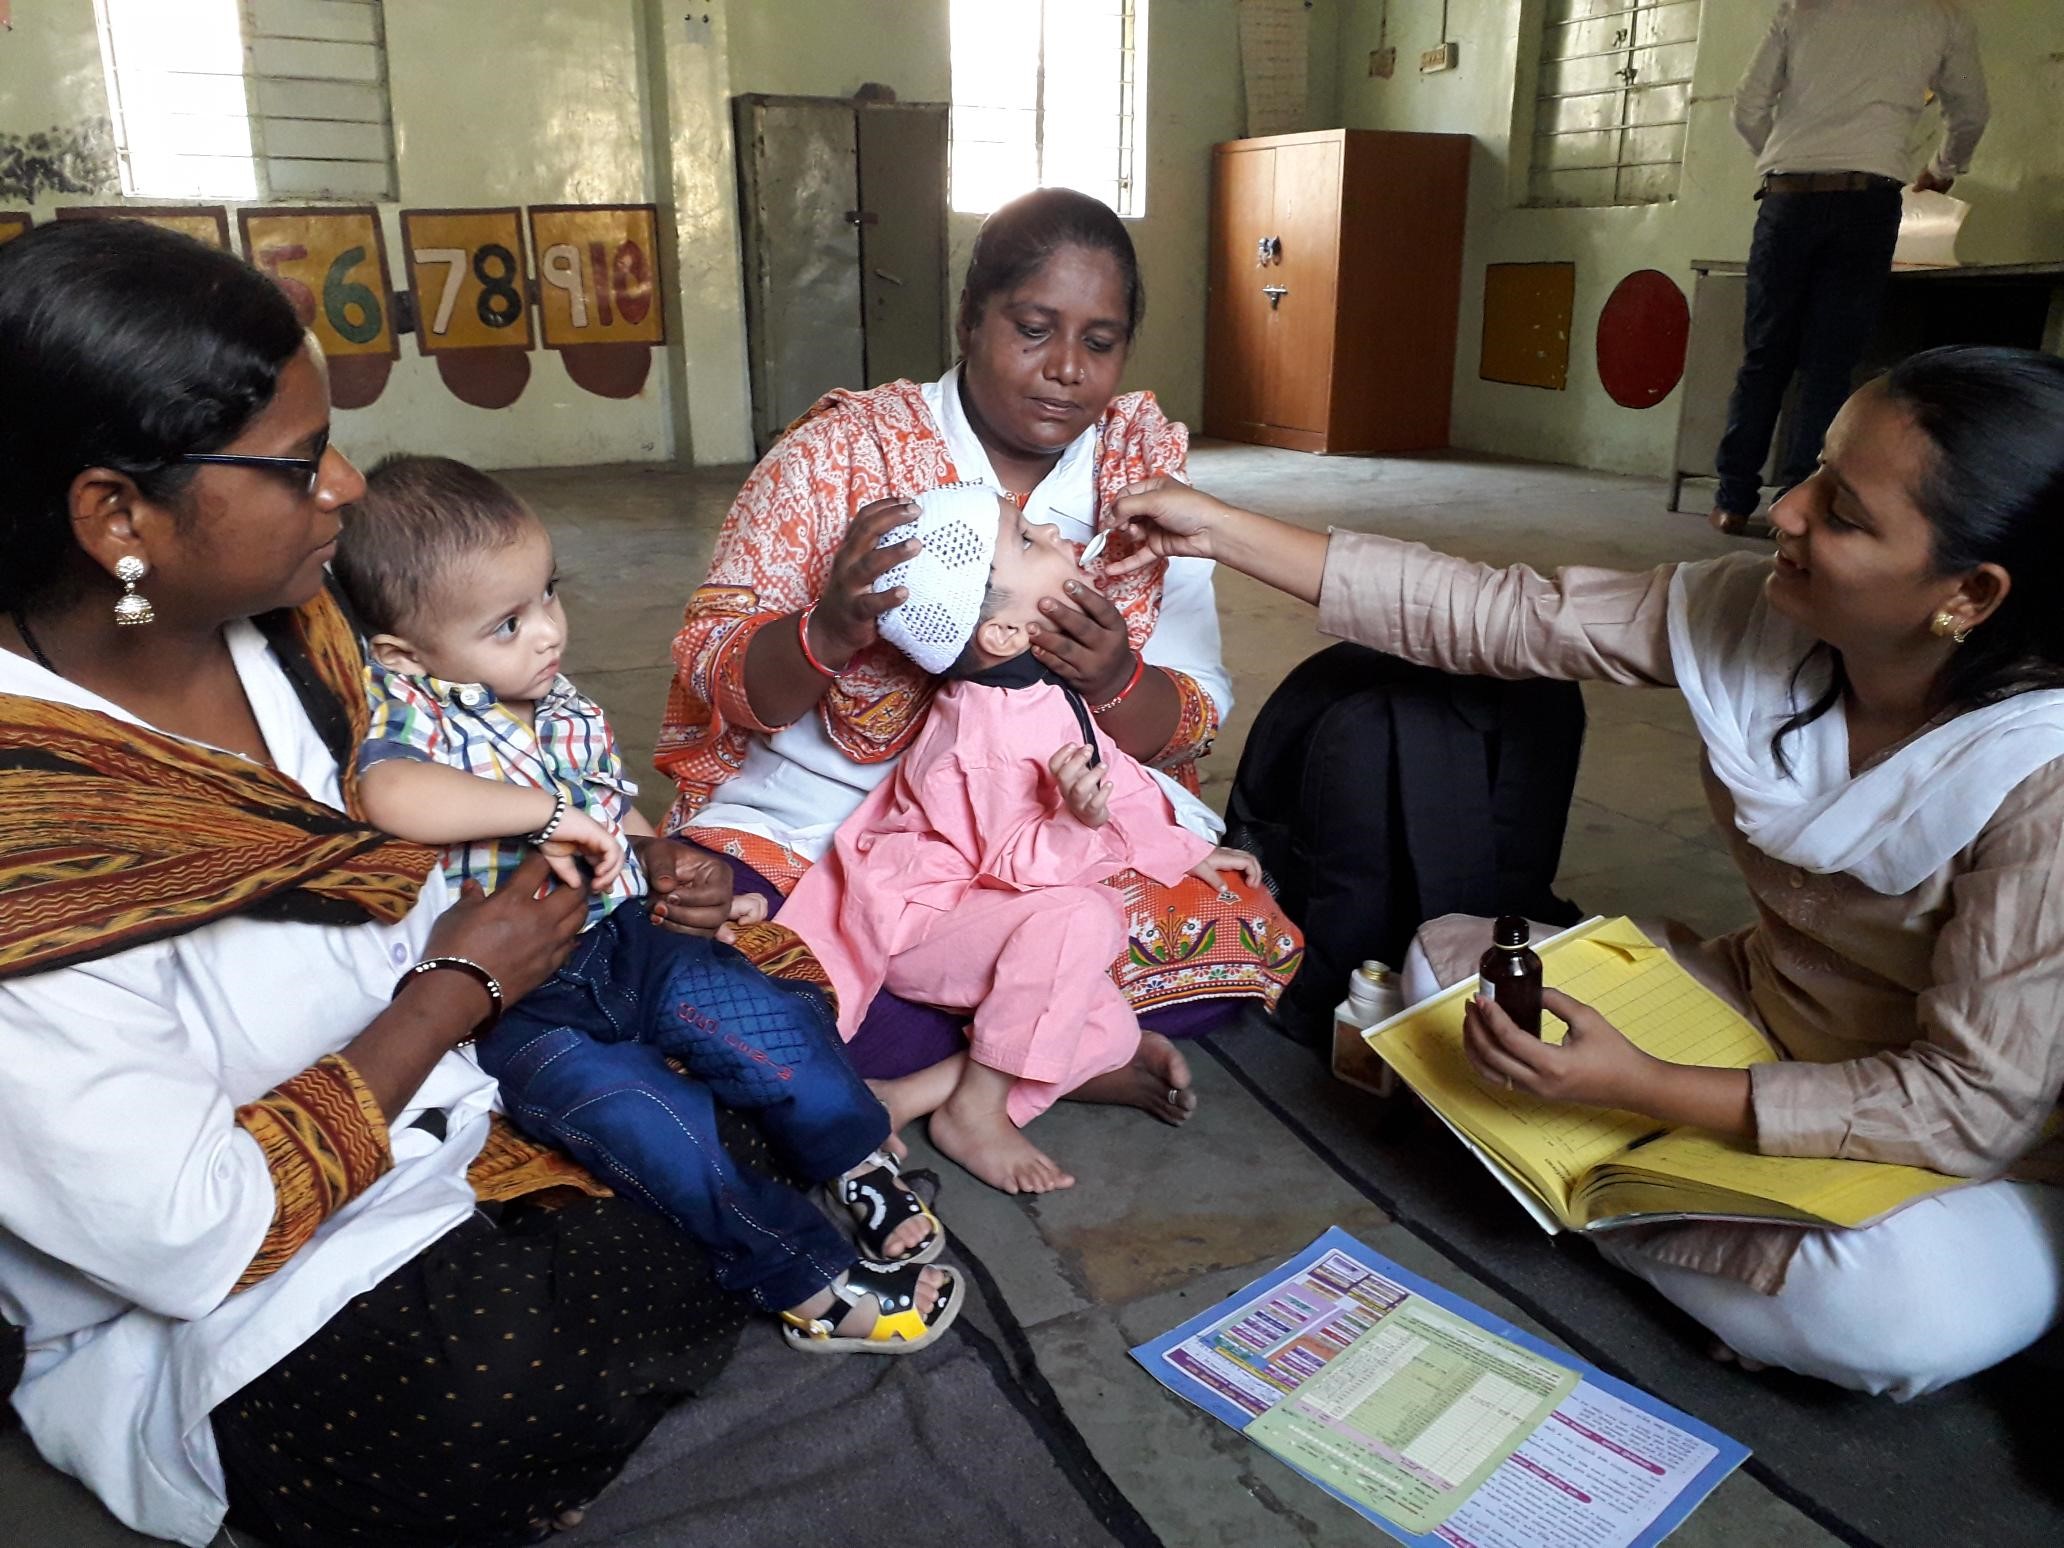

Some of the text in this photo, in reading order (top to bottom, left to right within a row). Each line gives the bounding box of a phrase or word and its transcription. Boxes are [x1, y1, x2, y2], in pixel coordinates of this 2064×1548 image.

[260, 243, 382, 344] 5 6
[414, 244, 522, 335] 7 8
[543, 239, 652, 328] 9 10
